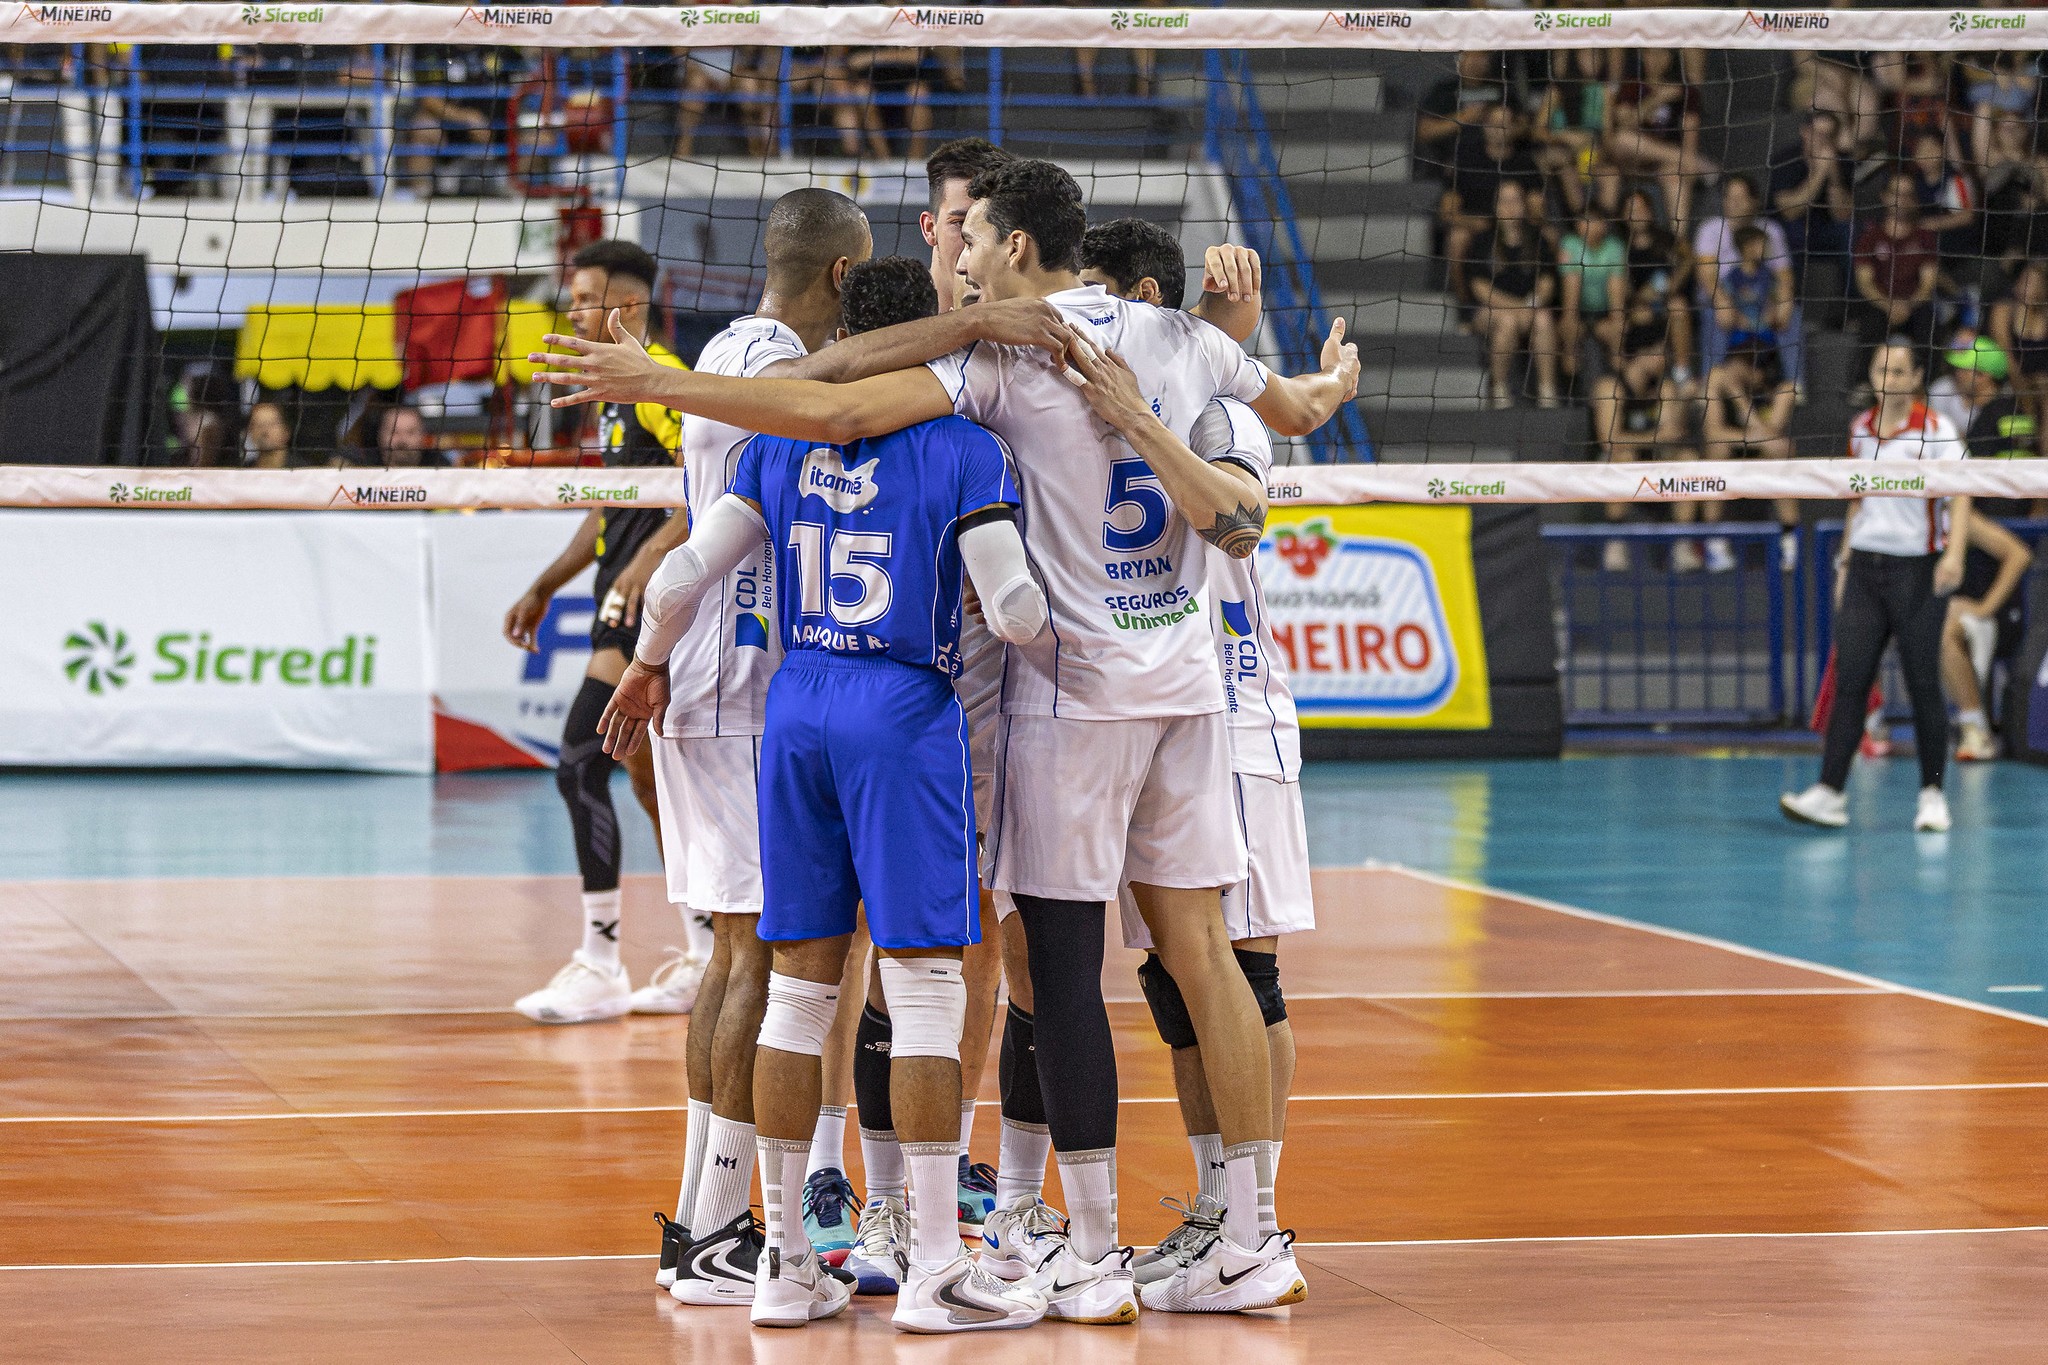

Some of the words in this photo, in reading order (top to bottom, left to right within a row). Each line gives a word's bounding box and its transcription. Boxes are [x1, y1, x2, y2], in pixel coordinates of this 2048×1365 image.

[41, 6, 112, 22] MINEIRO
[265, 8, 323, 22] Sicredi
[484, 9, 552, 25] MINEIRO
[703, 10, 760, 24] Sicredi
[916, 9, 984, 25] MINEIRO
[1133, 13, 1189, 28] Sicredi
[1345, 13, 1412, 28] MINEIRO
[1556, 13, 1612, 28] Sicredi
[1763, 13, 1830, 29] MINEIRO
[1971, 14, 2026, 29] Sicredi
[810, 466, 862, 495] itamé
[1450, 480, 1505, 495] Sicredi
[1660, 478, 1726, 492] MINEIRO
[1871, 475, 1926, 490] Sicredi
[133, 485, 192, 501] Sicredi
[356, 487, 427, 502] MINEIRO
[581, 485, 639, 500] Sicredi
[1267, 486, 1302, 499] EIRO
[1103, 457, 1168, 552] 5
[787, 521, 893, 627] 15
[1105, 555, 1172, 580] BRYAN
[735, 566, 757, 609] CDL
[762, 586, 772, 609] Belo
[1105, 585, 1189, 611] SEGUROS
[1112, 597, 1199, 630] Unimed
[1224, 643, 1235, 665] Belo
[1271, 622, 1433, 674] NEIRO
[151, 631, 378, 687] Sicredi
[936, 642, 953, 674] DL
[1238, 640, 1258, 682] CDL
[1224, 668, 1238, 714] Horizonte
[715, 1154, 738, 1170] N1
[736, 1218, 751, 1231] NIKE
